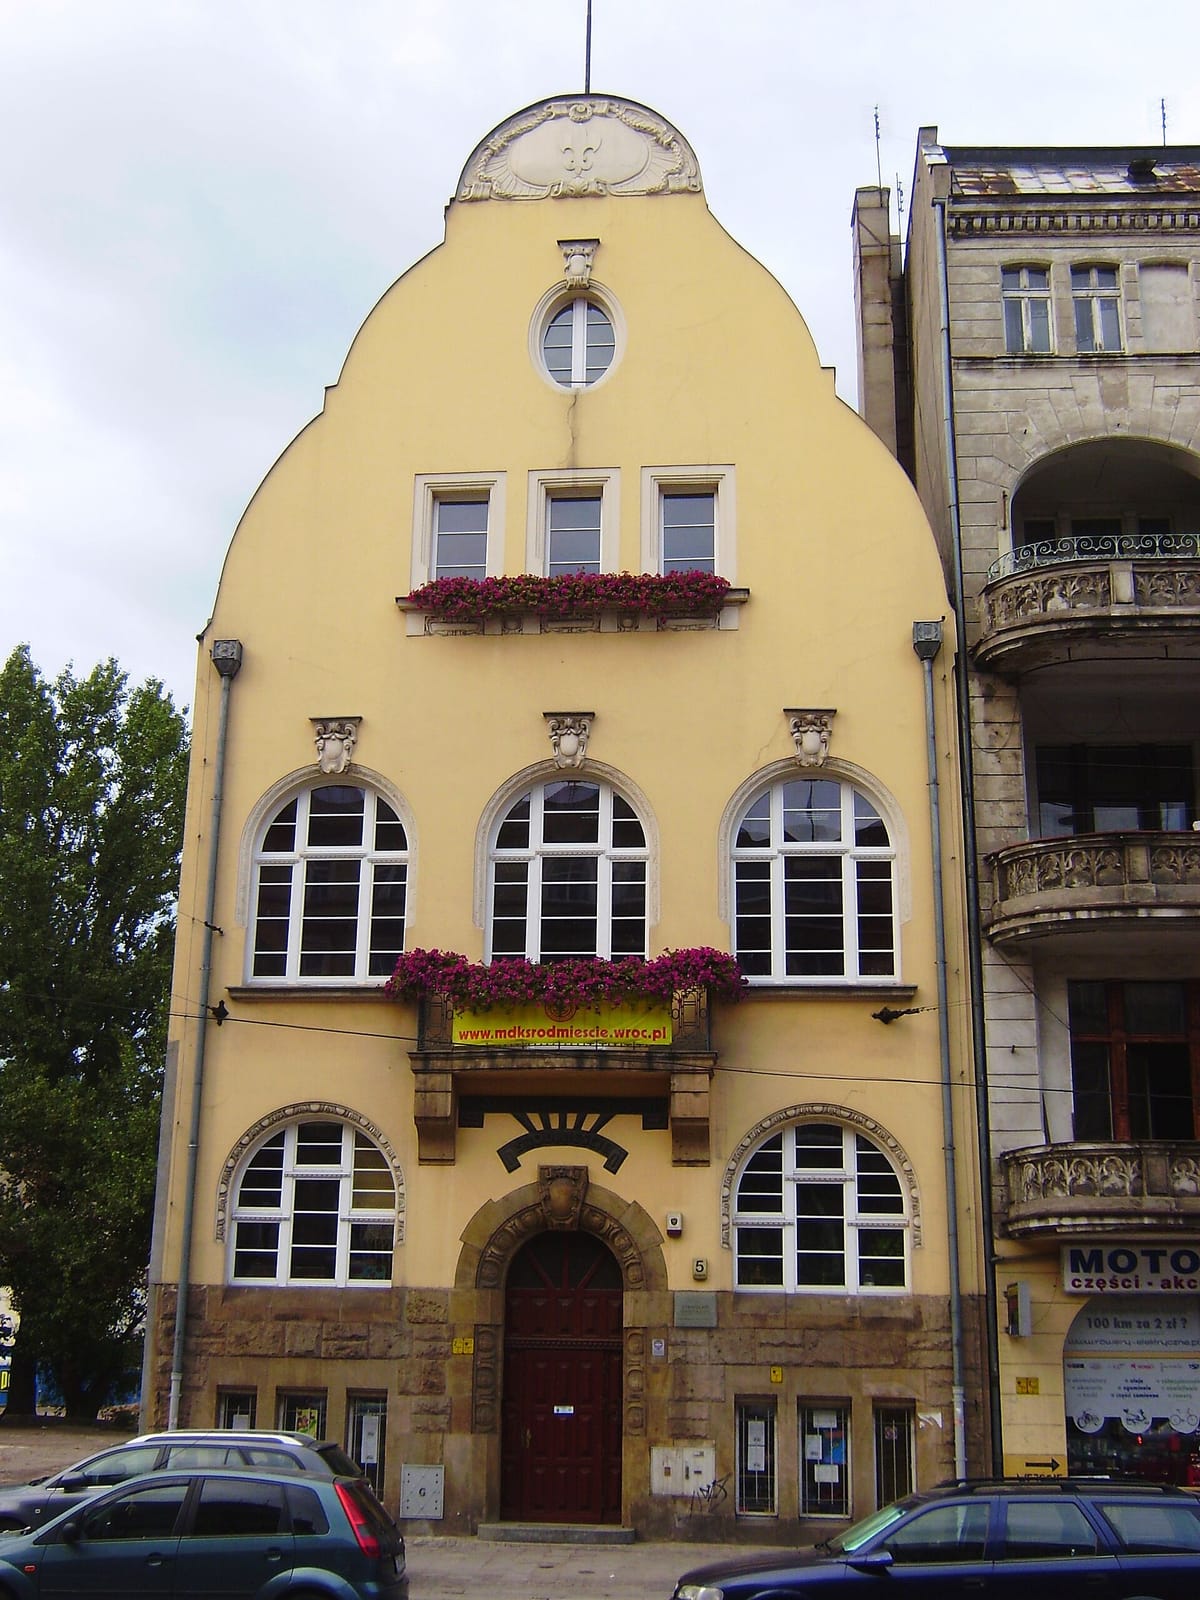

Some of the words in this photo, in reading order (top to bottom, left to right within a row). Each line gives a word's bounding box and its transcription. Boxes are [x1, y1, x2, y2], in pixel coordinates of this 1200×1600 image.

[458, 1026, 666, 1041] www.mdksrodmiescie.wroc.pl
[695, 1260, 704, 1272] 5
[1070, 1249, 1200, 1274] MOTO
[1071, 1275, 1139, 1291] części
[1087, 1317, 1109, 1328] 100
[1113, 1317, 1132, 1328] km
[1136, 1320, 1150, 1328] za
[1154, 1318, 1162, 1329] 2
[1166, 1317, 1177, 1329] zł
